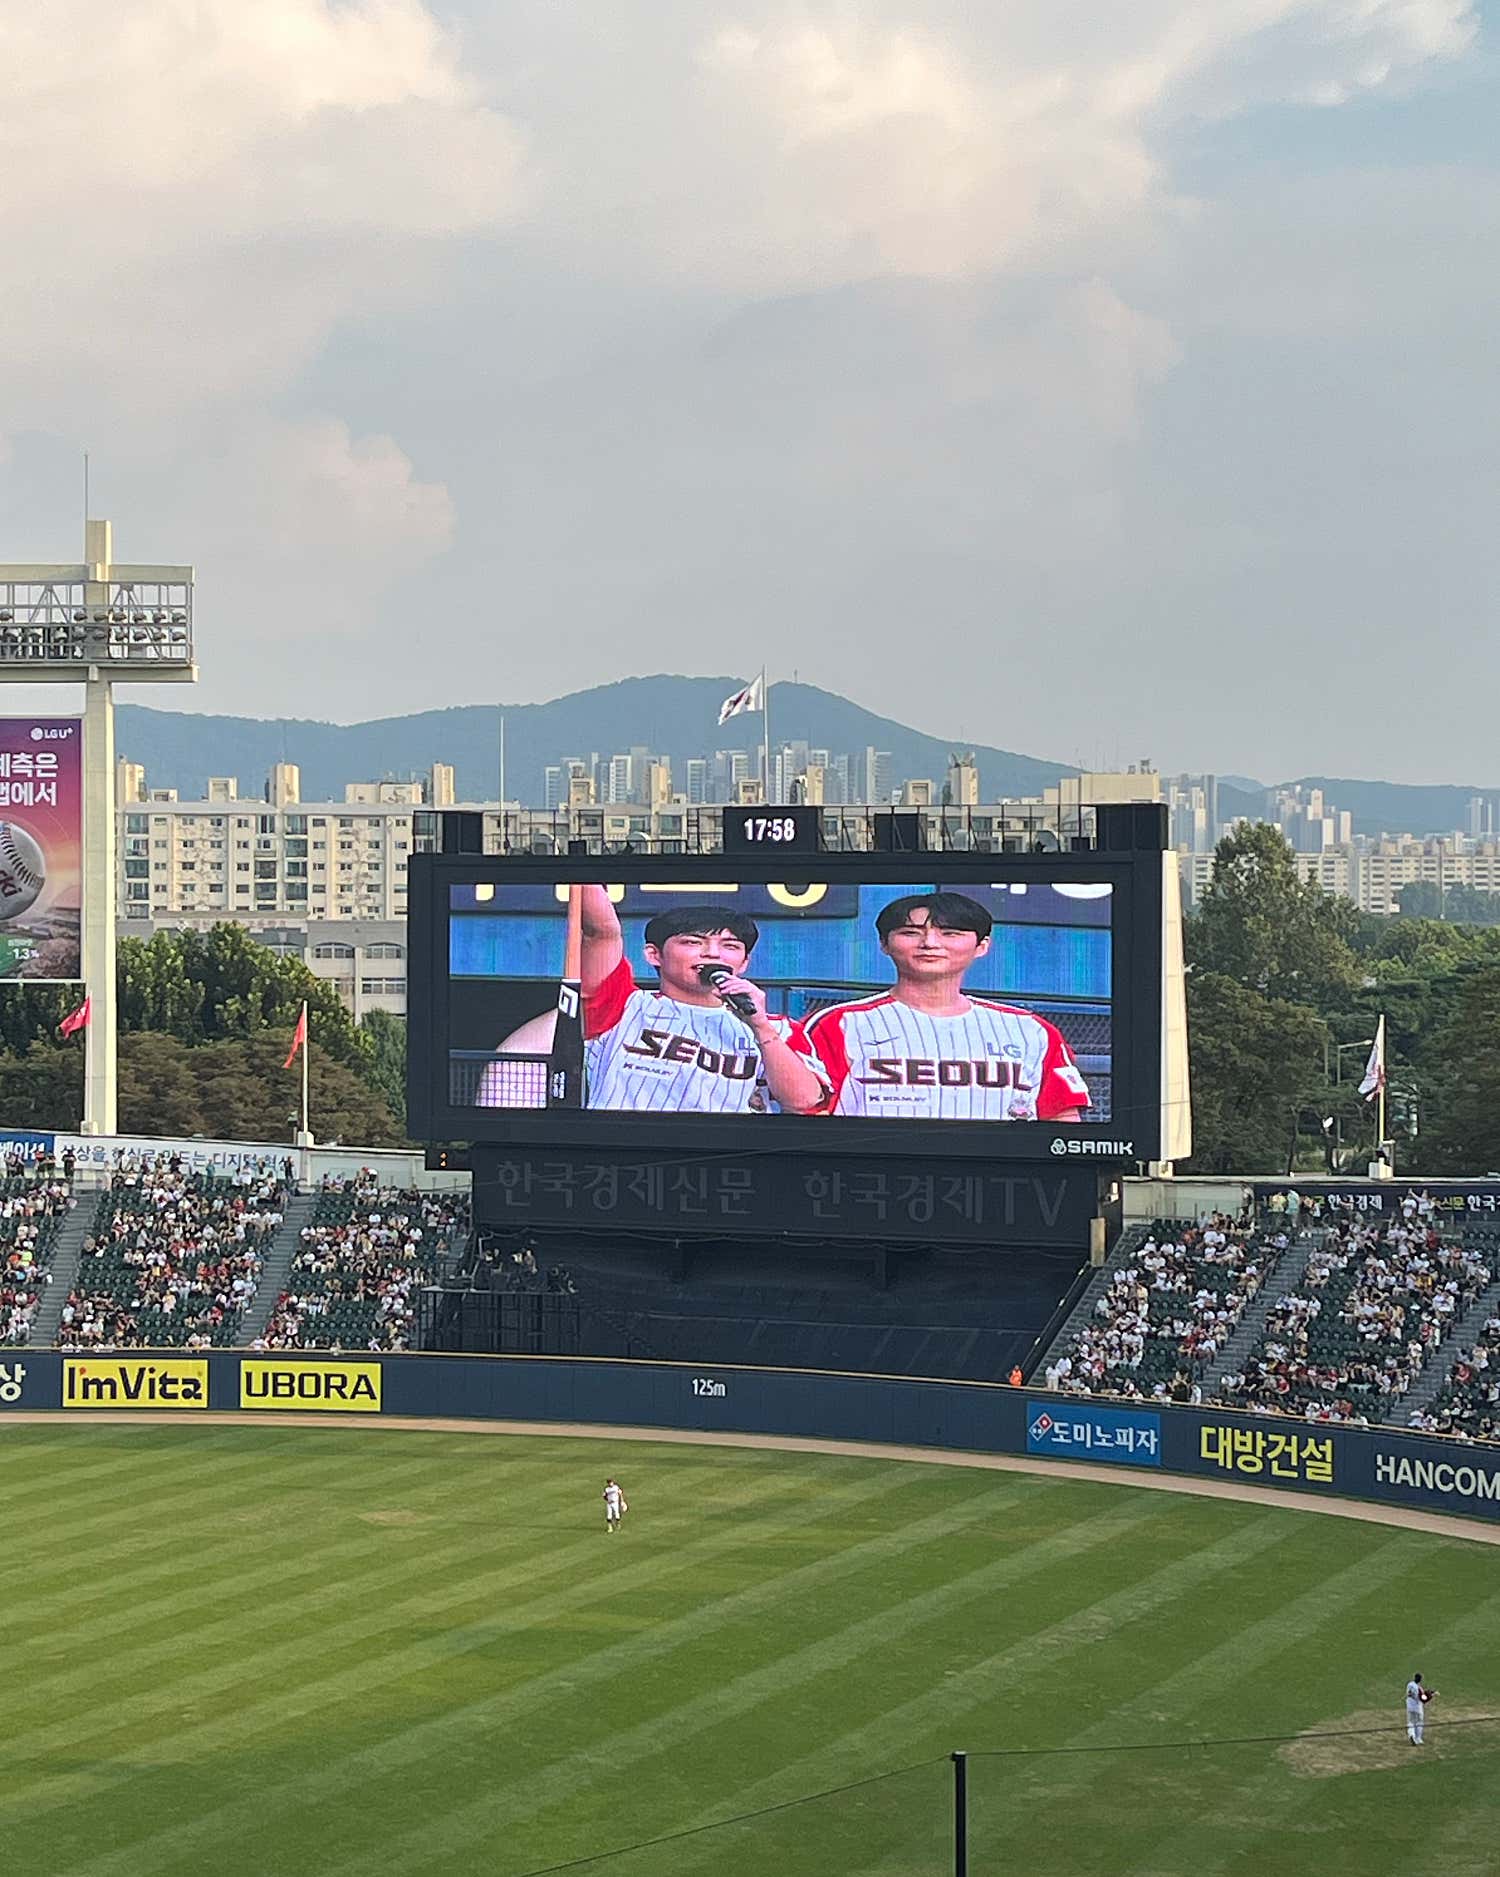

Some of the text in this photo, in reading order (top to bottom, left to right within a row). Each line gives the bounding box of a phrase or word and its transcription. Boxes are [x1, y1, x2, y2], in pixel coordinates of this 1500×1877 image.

[744, 818, 795, 841] 17:58
[622, 1028, 758, 1080] SEOU
[986, 1042, 1022, 1059] LG
[855, 1058, 1033, 1092] SEOUL
[1067, 1140, 1134, 1156] SAMIK
[497, 1160, 1068, 1227] 한국경제신문 한국경제TV
[1467, 1194, 1500, 1212] 한국
[245, 1371, 378, 1401] UBORA
[692, 1378, 726, 1397] 125m
[1051, 1421, 1159, 1456] 도미노피자
[1200, 1426, 1333, 1483] 대방건설
[1376, 1453, 1500, 1501] HANCOM
